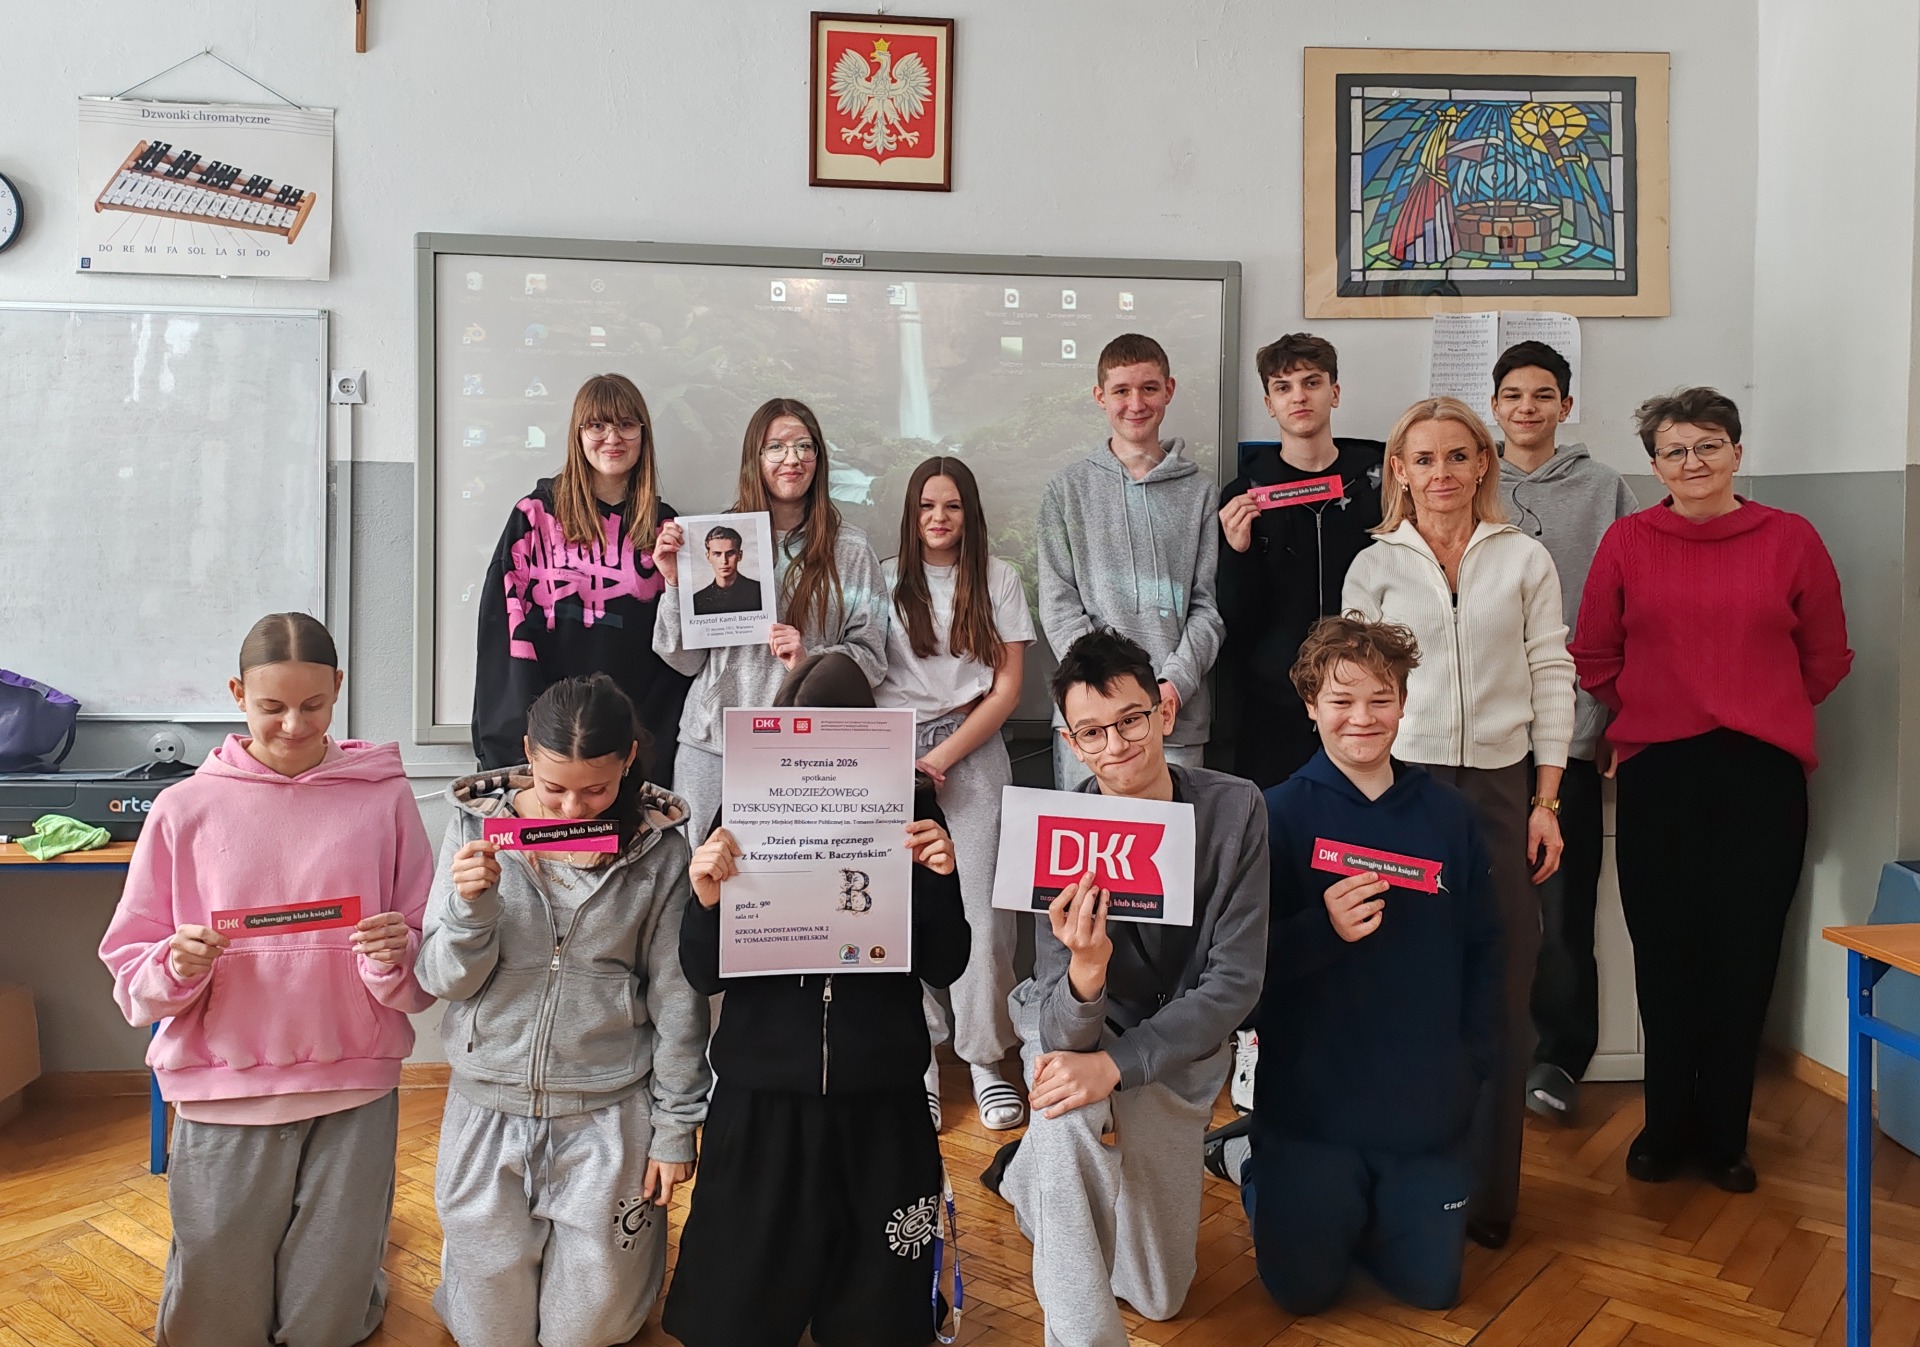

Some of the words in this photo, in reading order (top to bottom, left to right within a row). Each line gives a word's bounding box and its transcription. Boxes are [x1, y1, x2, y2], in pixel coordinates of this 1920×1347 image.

[141, 108, 190, 120] Dzwonki
[193, 109, 271, 125] chromatyczne
[0, 190, 6, 198] 2
[7, 208, 12, 216] 3
[98, 244, 113, 252] DO
[144, 245, 157, 253] MI
[167, 246, 178, 254] FA
[187, 246, 206, 255] SOL
[215, 248, 228, 256] LA
[237, 248, 246, 256] SI
[256, 249, 271, 257] DO
[824, 255, 862, 265] myBoard
[689, 617, 718, 626] Krzysztof
[720, 615, 738, 623] Kamil
[739, 613, 769, 622] Baczyński
[780, 758, 792, 767] 22
[794, 758, 834, 770] stycznia
[836, 758, 858, 767] 2026
[801, 774, 837, 783] spotkanie
[769, 786, 869, 797] MŁODZIEŻOWEGO
[732, 803, 819, 814] DYSKUSYJNEGO
[820, 803, 858, 813] KLUBU
[860, 802, 904, 815] KSIĄŻKI
[526, 829, 568, 841] dyskusyjny
[569, 826, 585, 835] klub
[587, 823, 613, 834] książki
[799, 836, 828, 847] pisma
[831, 836, 874, 847] ręcznego
[750, 851, 812, 862] Krzysztofem
[815, 851, 826, 860] K.
[1346, 856, 1382, 871] dyskusyjny
[1383, 863, 1397, 873] klub
[1398, 865, 1419, 877] książki
[735, 901, 758, 912] godz.
[1114, 899, 1130, 907] klub
[1131, 900, 1158, 910] książki
[250, 914, 292, 925] dyskusyjny
[292, 912, 309, 920] klub
[310, 909, 335, 918] książki
[763, 926, 813, 934] PODSTAWOWA
[743, 935, 790, 943] TOMASZOWIE
